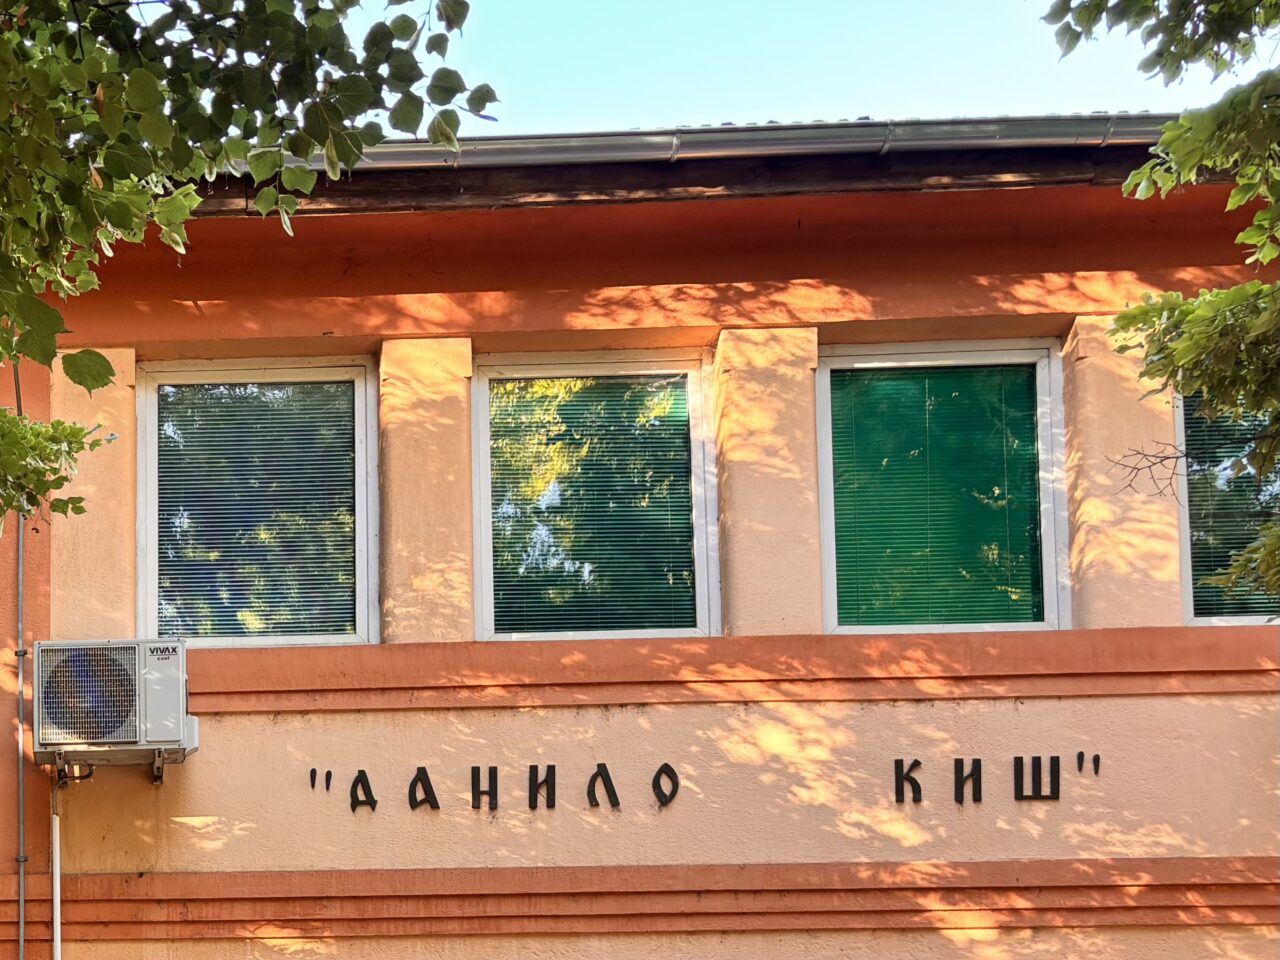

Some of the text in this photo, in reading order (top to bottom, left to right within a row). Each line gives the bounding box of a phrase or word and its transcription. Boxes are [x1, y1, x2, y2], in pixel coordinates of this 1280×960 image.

[149, 646, 178, 654] VIVAX
[309, 762, 680, 814] "ДАНИЛО
[894, 751, 1101, 806] КИШ"
